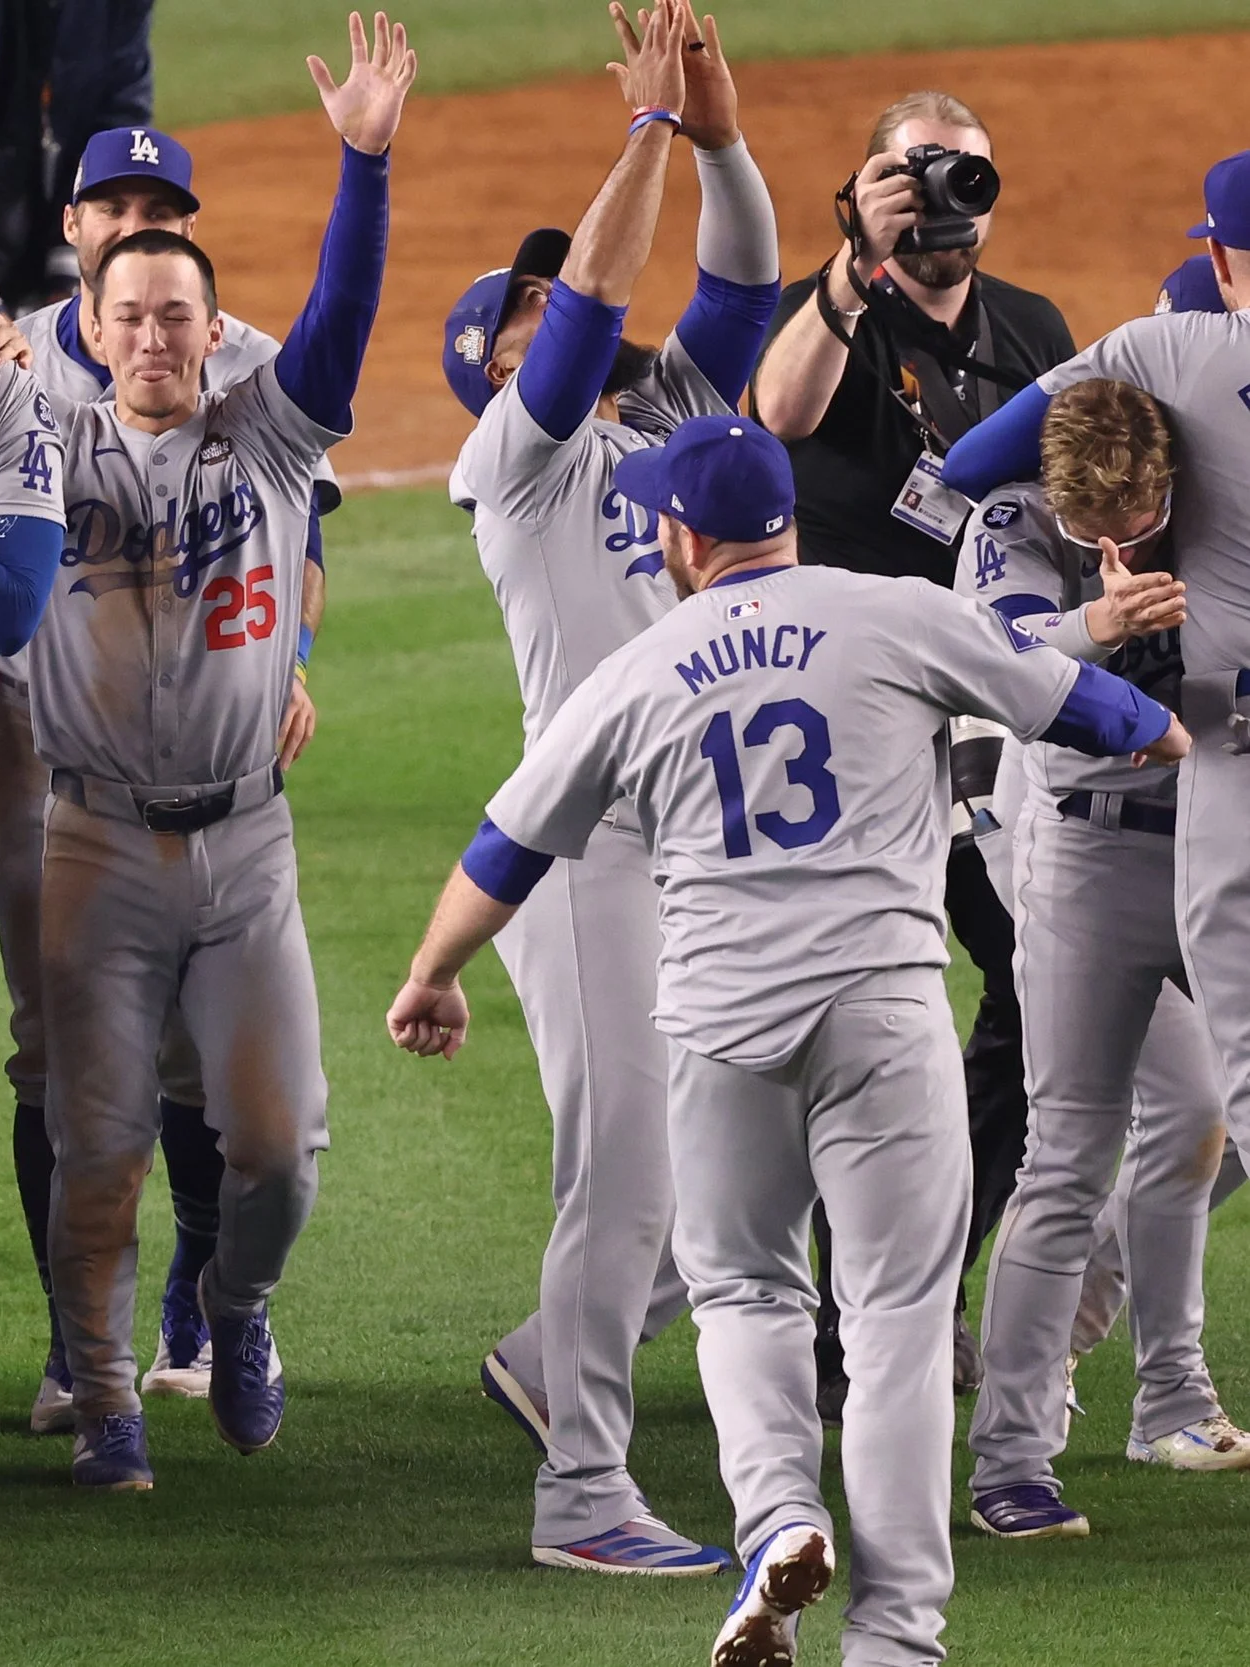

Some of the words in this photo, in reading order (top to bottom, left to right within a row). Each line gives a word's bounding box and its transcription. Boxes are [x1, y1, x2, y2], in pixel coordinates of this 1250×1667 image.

[130, 130, 159, 165] LA
[19, 430, 52, 495] LA
[974, 532, 1007, 589] LA
[202, 564, 277, 651] 25
[674, 625, 827, 695] MUNCY
[700, 698, 841, 859] 13
